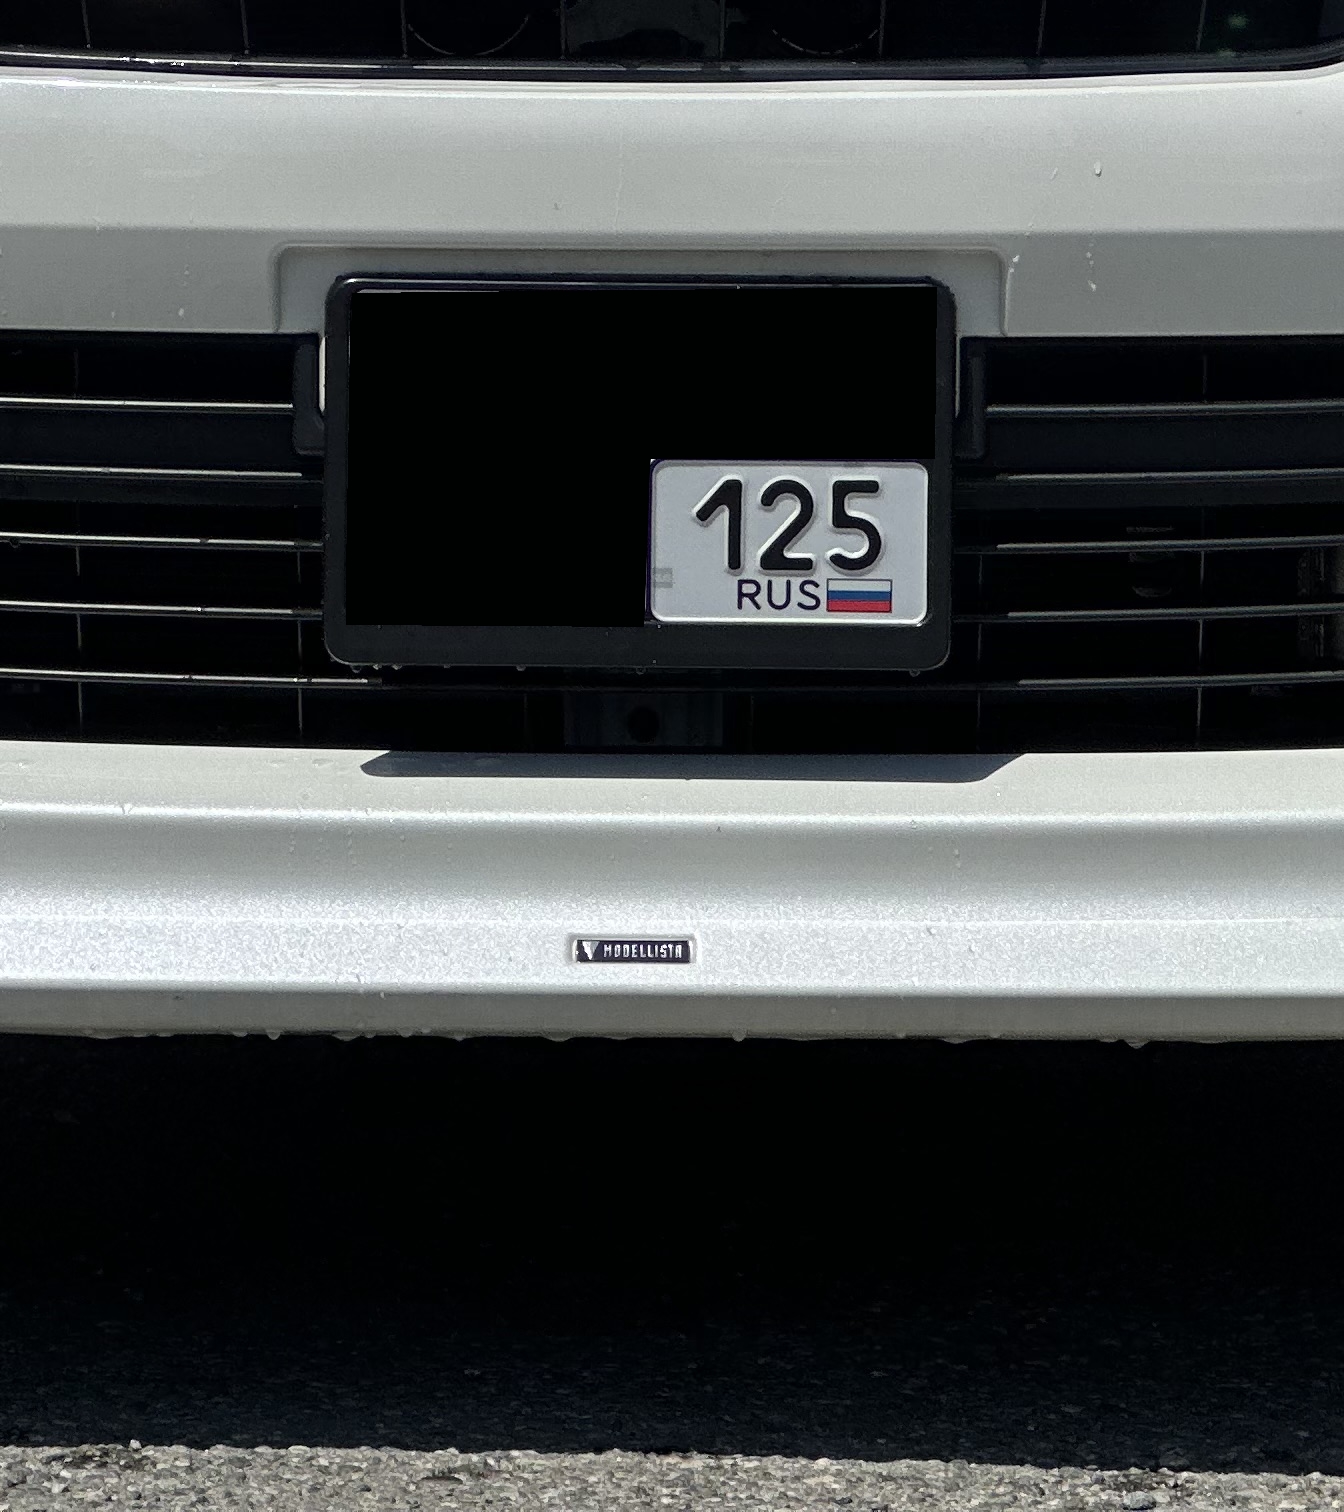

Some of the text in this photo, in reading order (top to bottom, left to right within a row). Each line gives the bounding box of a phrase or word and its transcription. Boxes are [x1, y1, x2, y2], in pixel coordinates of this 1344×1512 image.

[694, 478, 883, 571] 125
[736, 578, 822, 610] RUS
[603, 944, 683, 959] MODELLISTA
